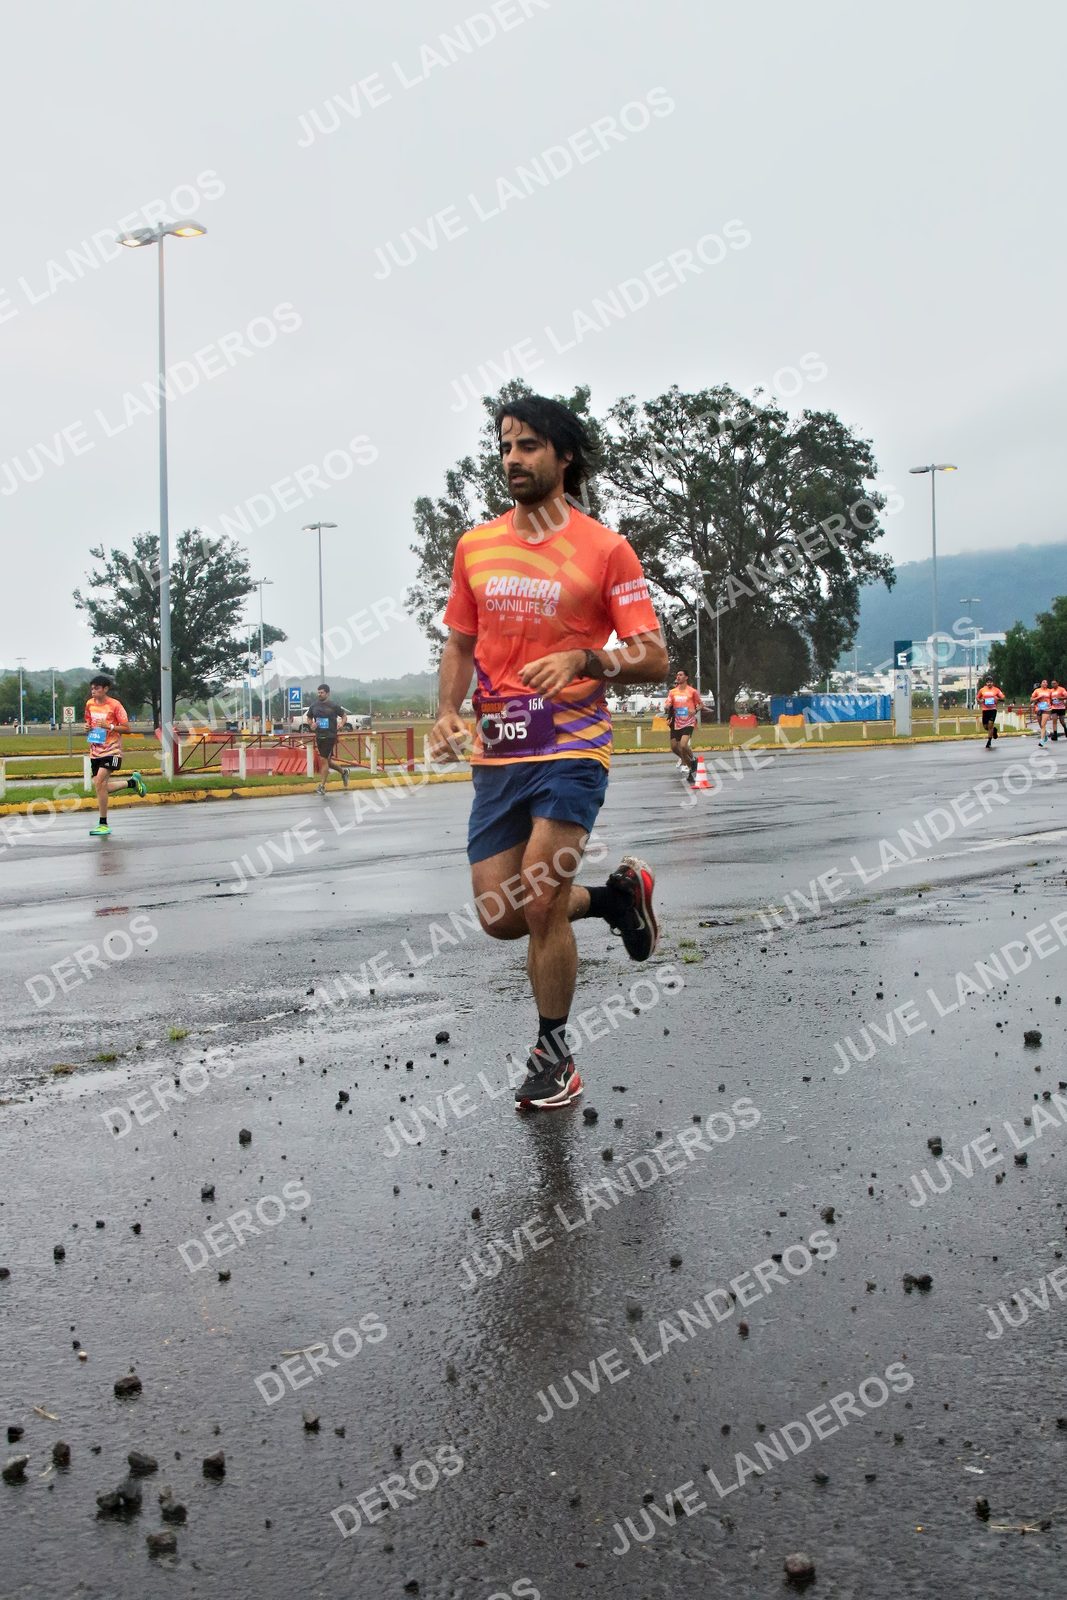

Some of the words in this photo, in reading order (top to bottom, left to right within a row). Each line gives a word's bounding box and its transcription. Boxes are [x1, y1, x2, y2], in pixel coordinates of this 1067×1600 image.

[485, 576, 561, 601] CARRERA
[486, 599, 540, 615] OMNILIFE
[897, 652, 907, 666] E
[495, 721, 528, 740] 705
